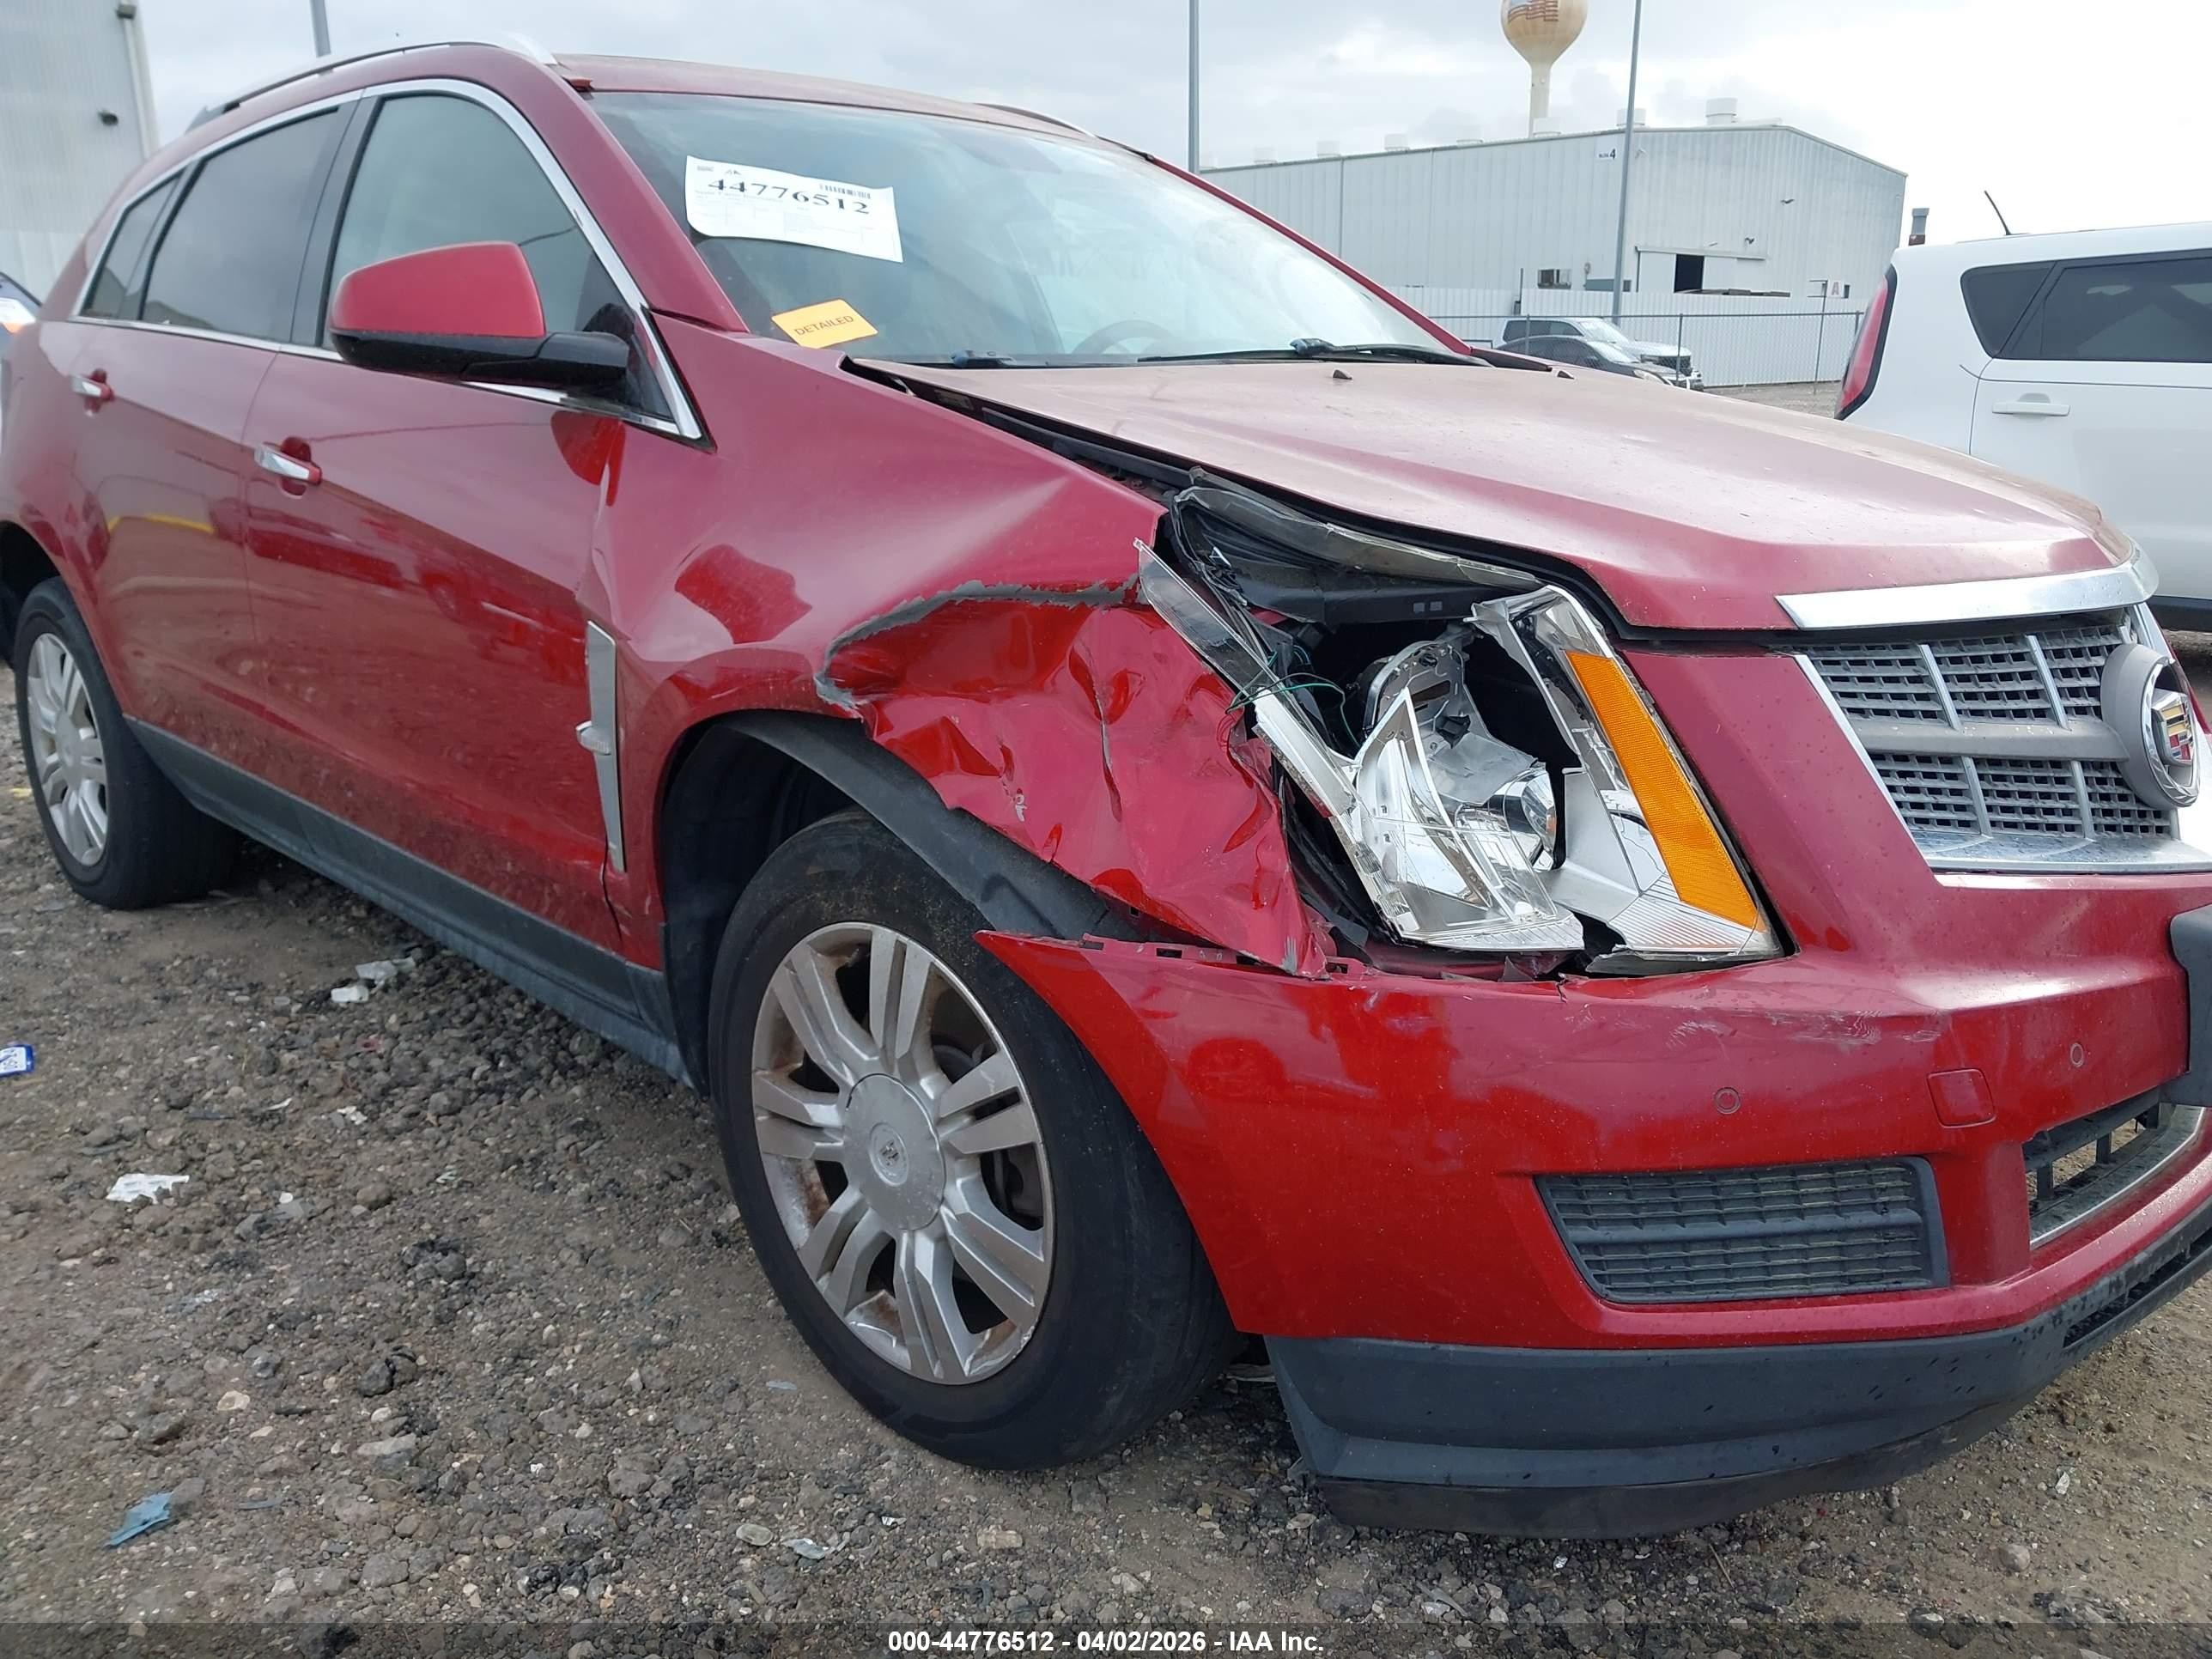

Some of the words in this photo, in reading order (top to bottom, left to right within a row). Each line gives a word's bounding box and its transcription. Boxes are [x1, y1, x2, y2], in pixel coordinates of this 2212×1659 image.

[1609, 148, 1616, 161] 4
[708, 178, 870, 215] 44776512
[794, 314, 854, 336] DETAILED
